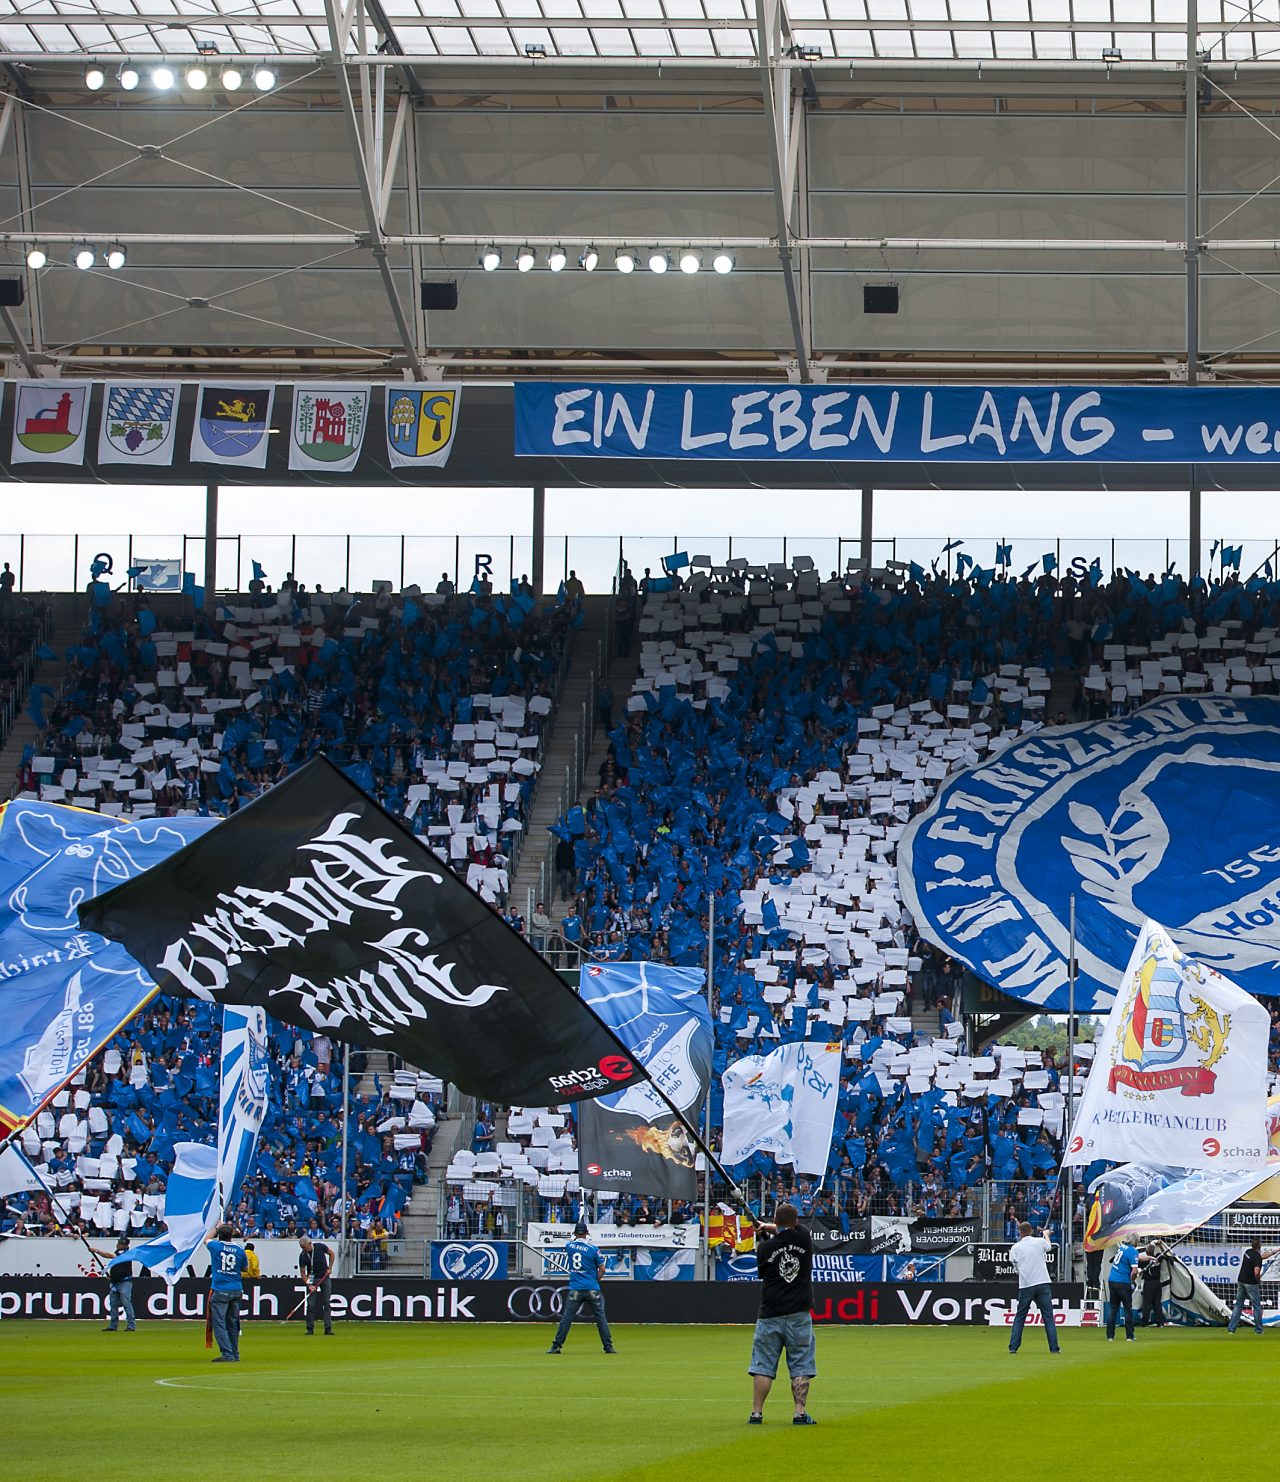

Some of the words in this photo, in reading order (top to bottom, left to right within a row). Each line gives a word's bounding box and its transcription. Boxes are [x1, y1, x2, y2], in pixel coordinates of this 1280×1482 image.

[551, 388, 656, 448] EIN
[680, 390, 900, 454] LEBEN
[919, 391, 1115, 456] LANG
[475, 553, 494, 575] R
[926, 698, 1249, 850] FANSZENE
[1222, 1146, 1261, 1157] schaa
[603, 1168, 632, 1178] schaa
[830, 1229, 866, 1242] Tigers
[923, 1225, 974, 1234] HOFFENHEIM
[915, 1235, 971, 1243] UNDERCOVER
[393, 1245, 399, 1253] R
[977, 1248, 1012, 1263] Blac
[220, 1251, 236, 1270] 19
[572, 1252, 583, 1269] 8
[811, 1290, 879, 1320] udi
